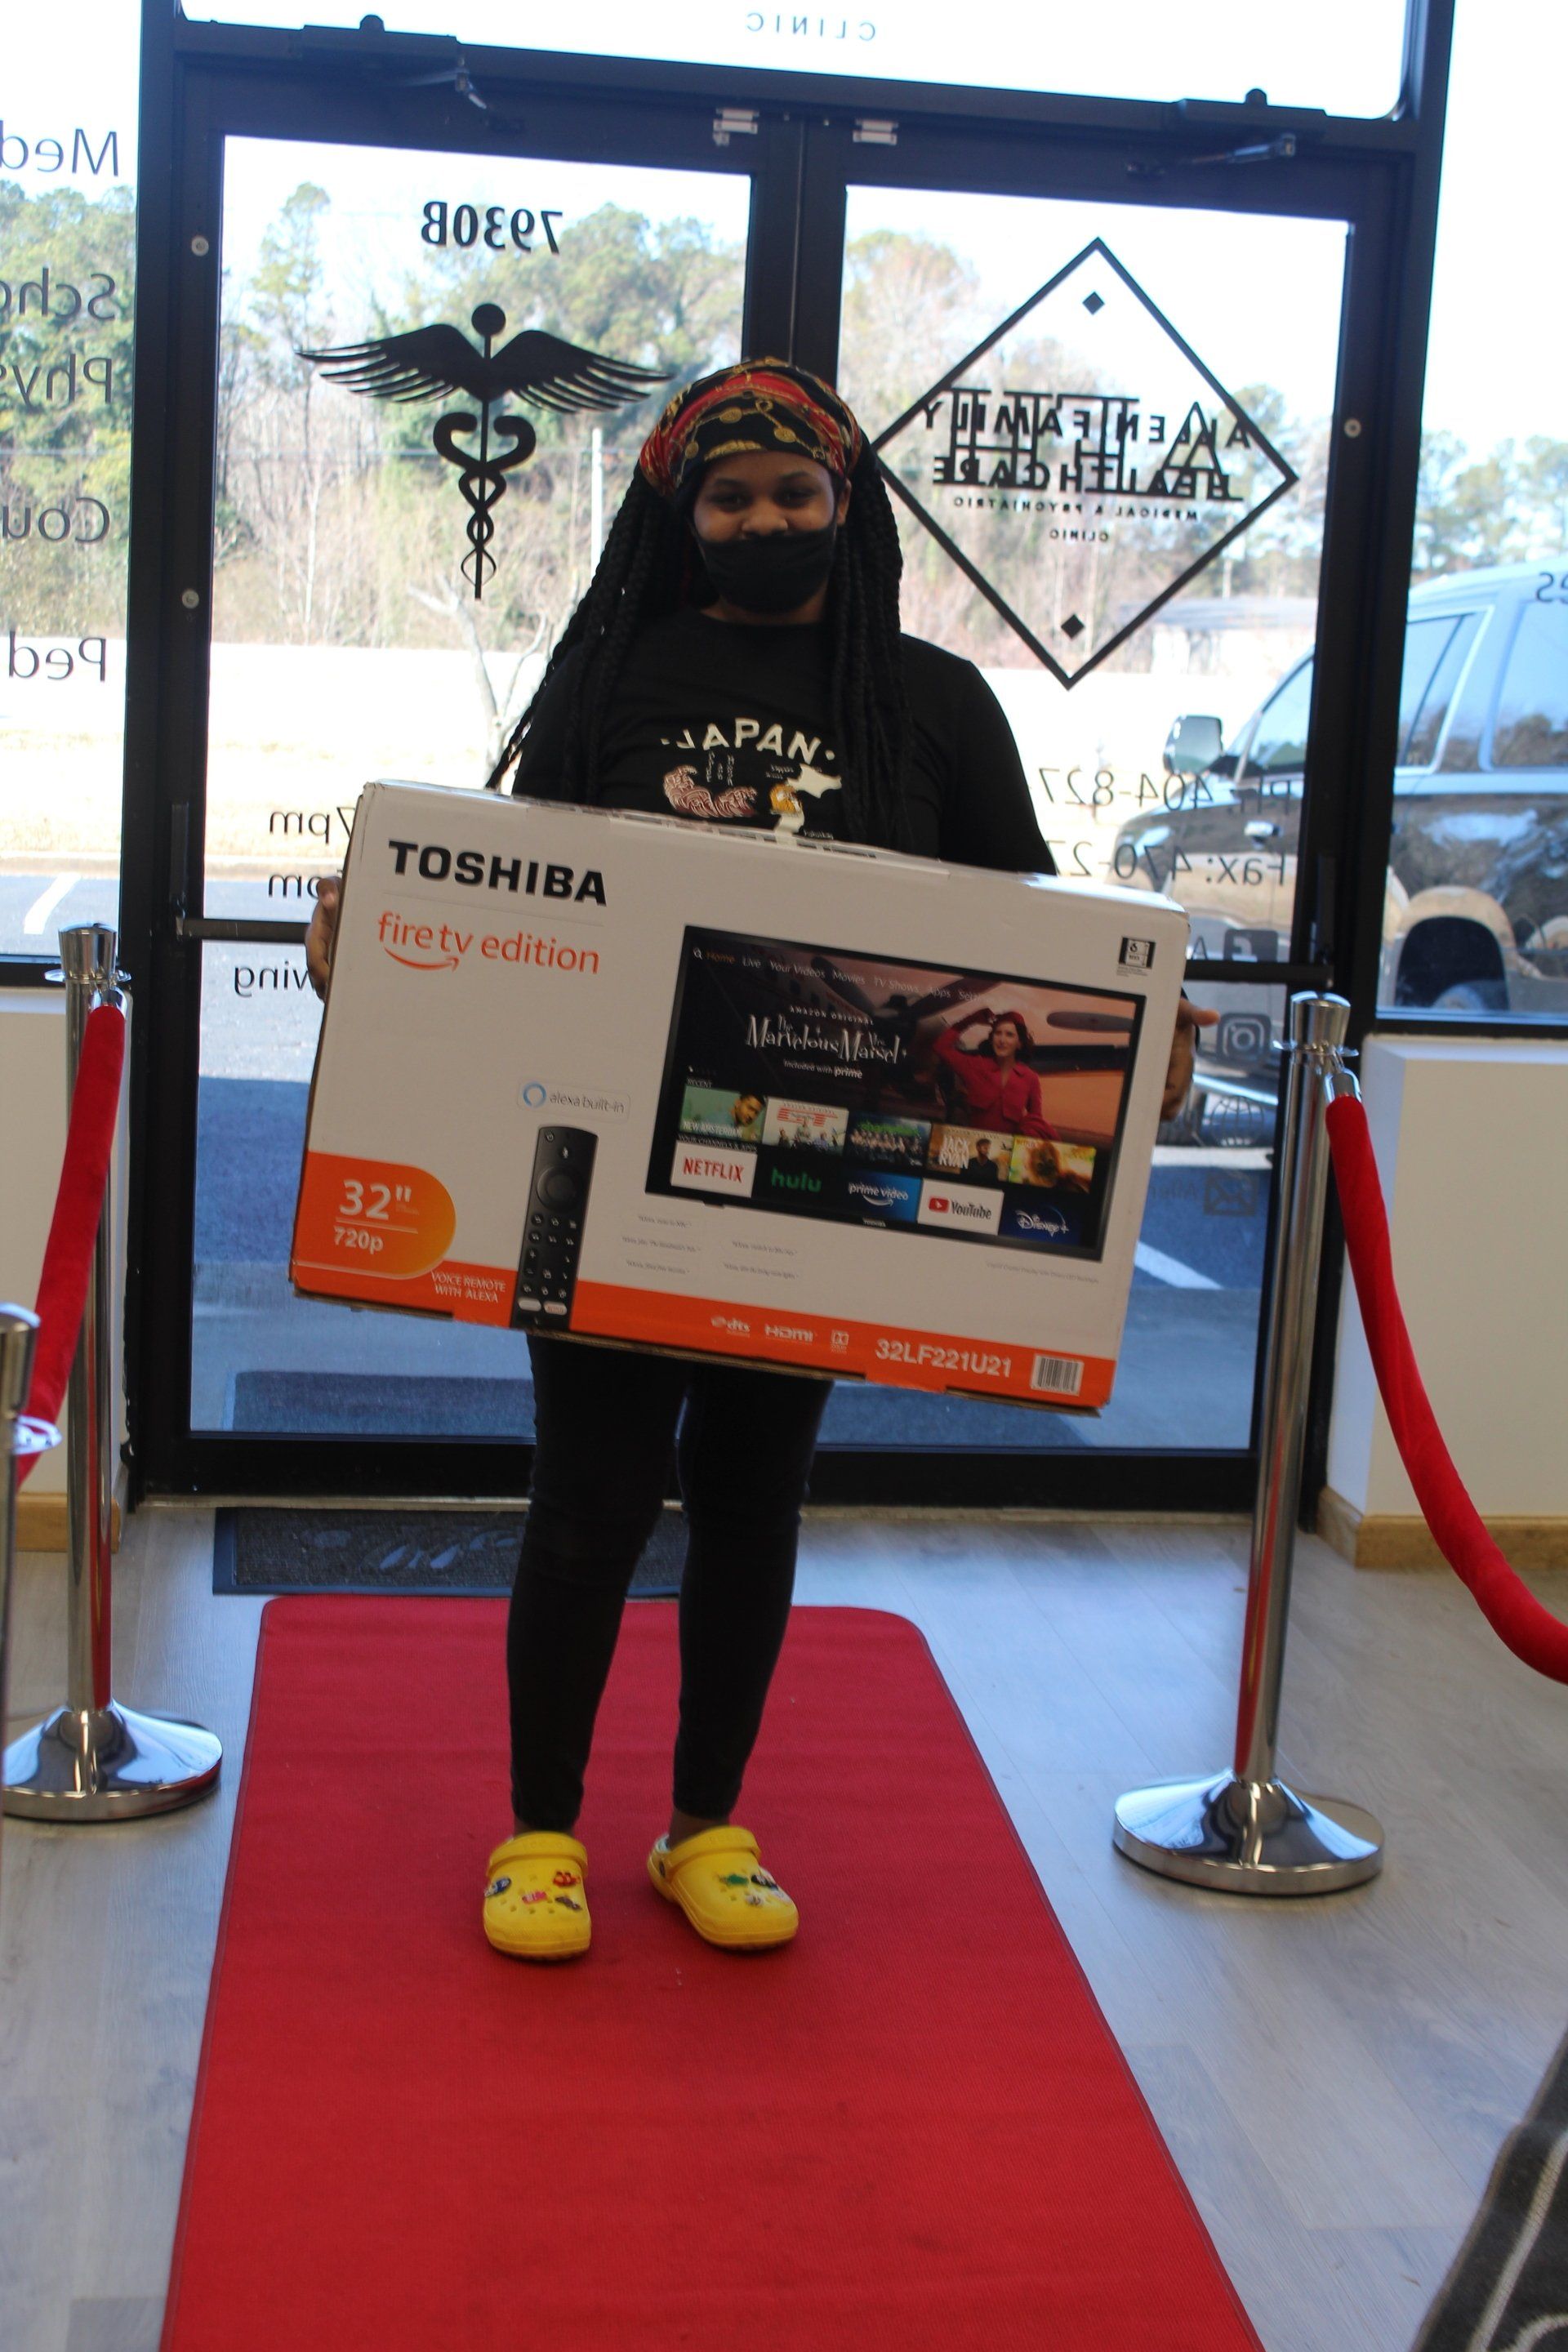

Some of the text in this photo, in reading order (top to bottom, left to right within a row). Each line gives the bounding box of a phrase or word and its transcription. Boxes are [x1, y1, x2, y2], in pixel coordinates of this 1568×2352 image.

[388, 839, 608, 907] TOSHIBA
[480, 929, 600, 975] edition
[706, 948, 735, 964] Home
[742, 956, 761, 969] Live
[769, 960, 791, 973] Your
[793, 963, 826, 979] Videos
[833, 970, 866, 986] Movies
[874, 975, 888, 987] TV
[889, 978, 920, 993] Shows
[789, 1004, 874, 1026] AMAZON ORIGINAL
[783, 1058, 863, 1079] Included with prime
[549, 1091, 625, 1115] alexa built-in
[683, 1156, 745, 1183] NETFLIX
[771, 1167, 823, 1193] hulu
[337, 1178, 412, 1221] 32"
[848, 1182, 909, 1201] prime video
[951, 1200, 992, 1220] YouTube
[333, 1226, 385, 1255] 720p
[431, 1271, 506, 1293] VOICE REMOTE
[434, 1285, 500, 1303] WITH ALEXA
[764, 1323, 814, 1343] HDMI
[875, 1337, 1013, 1379] 32LF221U21
